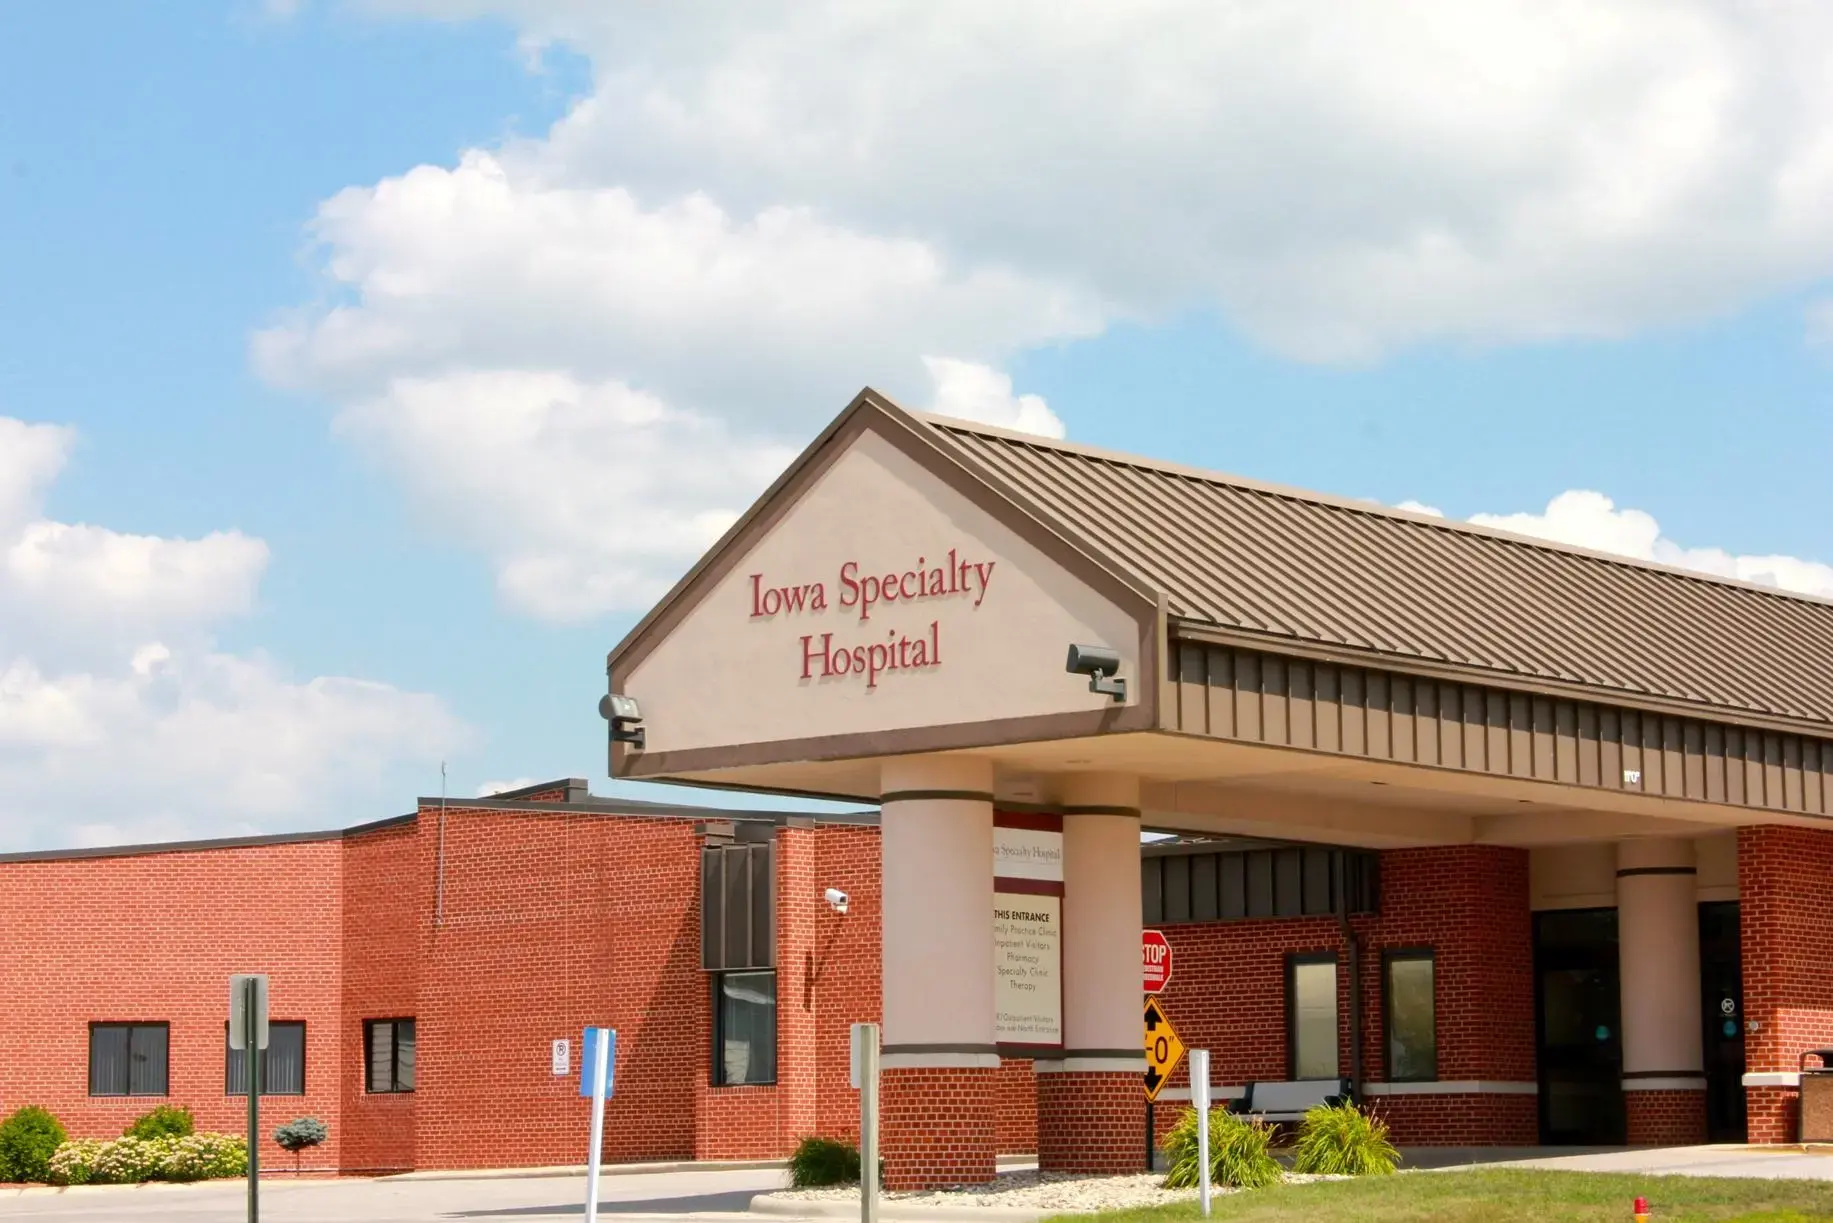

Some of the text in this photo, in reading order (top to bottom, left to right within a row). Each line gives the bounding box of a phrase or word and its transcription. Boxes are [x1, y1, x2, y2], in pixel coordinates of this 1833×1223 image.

[750, 548, 996, 620] Iowa Specialty
[800, 620, 942, 688] Hospital
[1001, 843, 1032, 859] Specialty
[1033, 846, 1060, 862] Hospital
[994, 909, 1050, 922] THIS ENTRANCE
[994, 924, 1057, 937] mily Practice Clinic
[1025, 940, 1050, 950] Visitors
[1006, 952, 1039, 965] Pharmacy
[997, 965, 1048, 977] Specialty Clinic
[1010, 980, 1036, 992] Therapy
